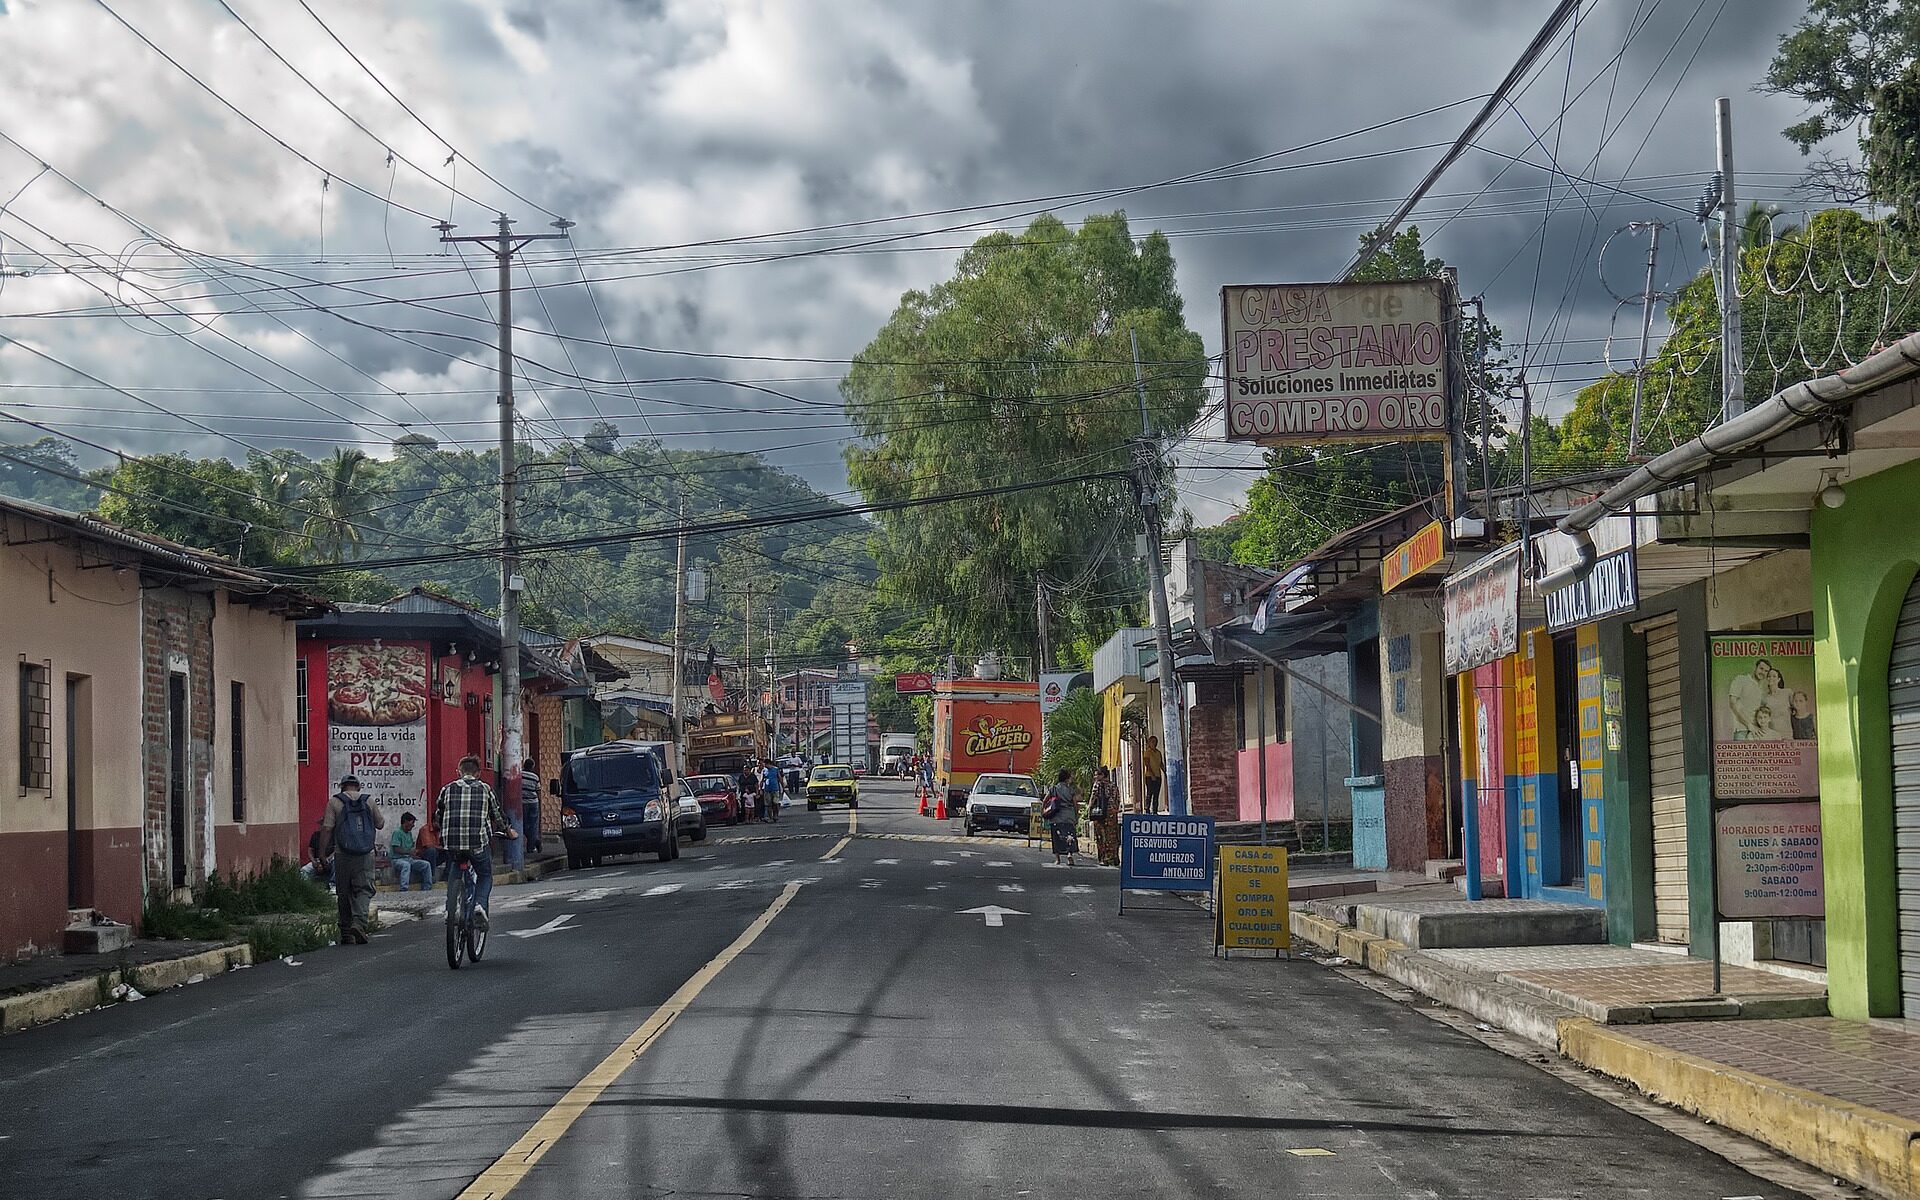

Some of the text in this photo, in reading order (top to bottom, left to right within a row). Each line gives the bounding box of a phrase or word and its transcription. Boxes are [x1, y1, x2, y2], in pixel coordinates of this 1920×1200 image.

[1240, 287, 1402, 325] CASA de
[1235, 322, 1442, 372] PRESTAMO
[1231, 395, 1446, 436] COMPRO ORO
[1546, 580, 1588, 628] CLINICA
[1589, 552, 1634, 616] MEDICA
[1713, 641, 1767, 656] CLINICA
[996, 724, 1024, 735] POLLO
[331, 727, 416, 744] Porque la vida
[332, 744, 385, 752] es como una
[966, 732, 1032, 756] CAMPERO
[351, 752, 401, 775] pizza
[384, 764, 414, 781] puedes
[374, 793, 384, 806] el
[1130, 820, 1208, 836] COMEDOR
[1721, 826, 1770, 834] HORARIOS
[1773, 825, 1785, 833] DE
[1134, 838, 1178, 849] DESAYUNOS
[1738, 837, 1819, 847] LUNES A SABADO
[1149, 852, 1195, 864] ALMUERZOS
[1234, 850, 1274, 860] CASA de
[1741, 851, 1774, 860] 8:00am
[1162, 867, 1204, 878] ANTOJITOS
[1229, 864, 1279, 874] PRESTAMO
[1248, 879, 1261, 888] SE
[1761, 876, 1799, 885] SABADO
[1235, 893, 1275, 902] COMPRA
[1238, 908, 1273, 917] ORO EN
[1228, 923, 1282, 932] CUALQUIER
[1237, 937, 1274, 945] ESTADO
